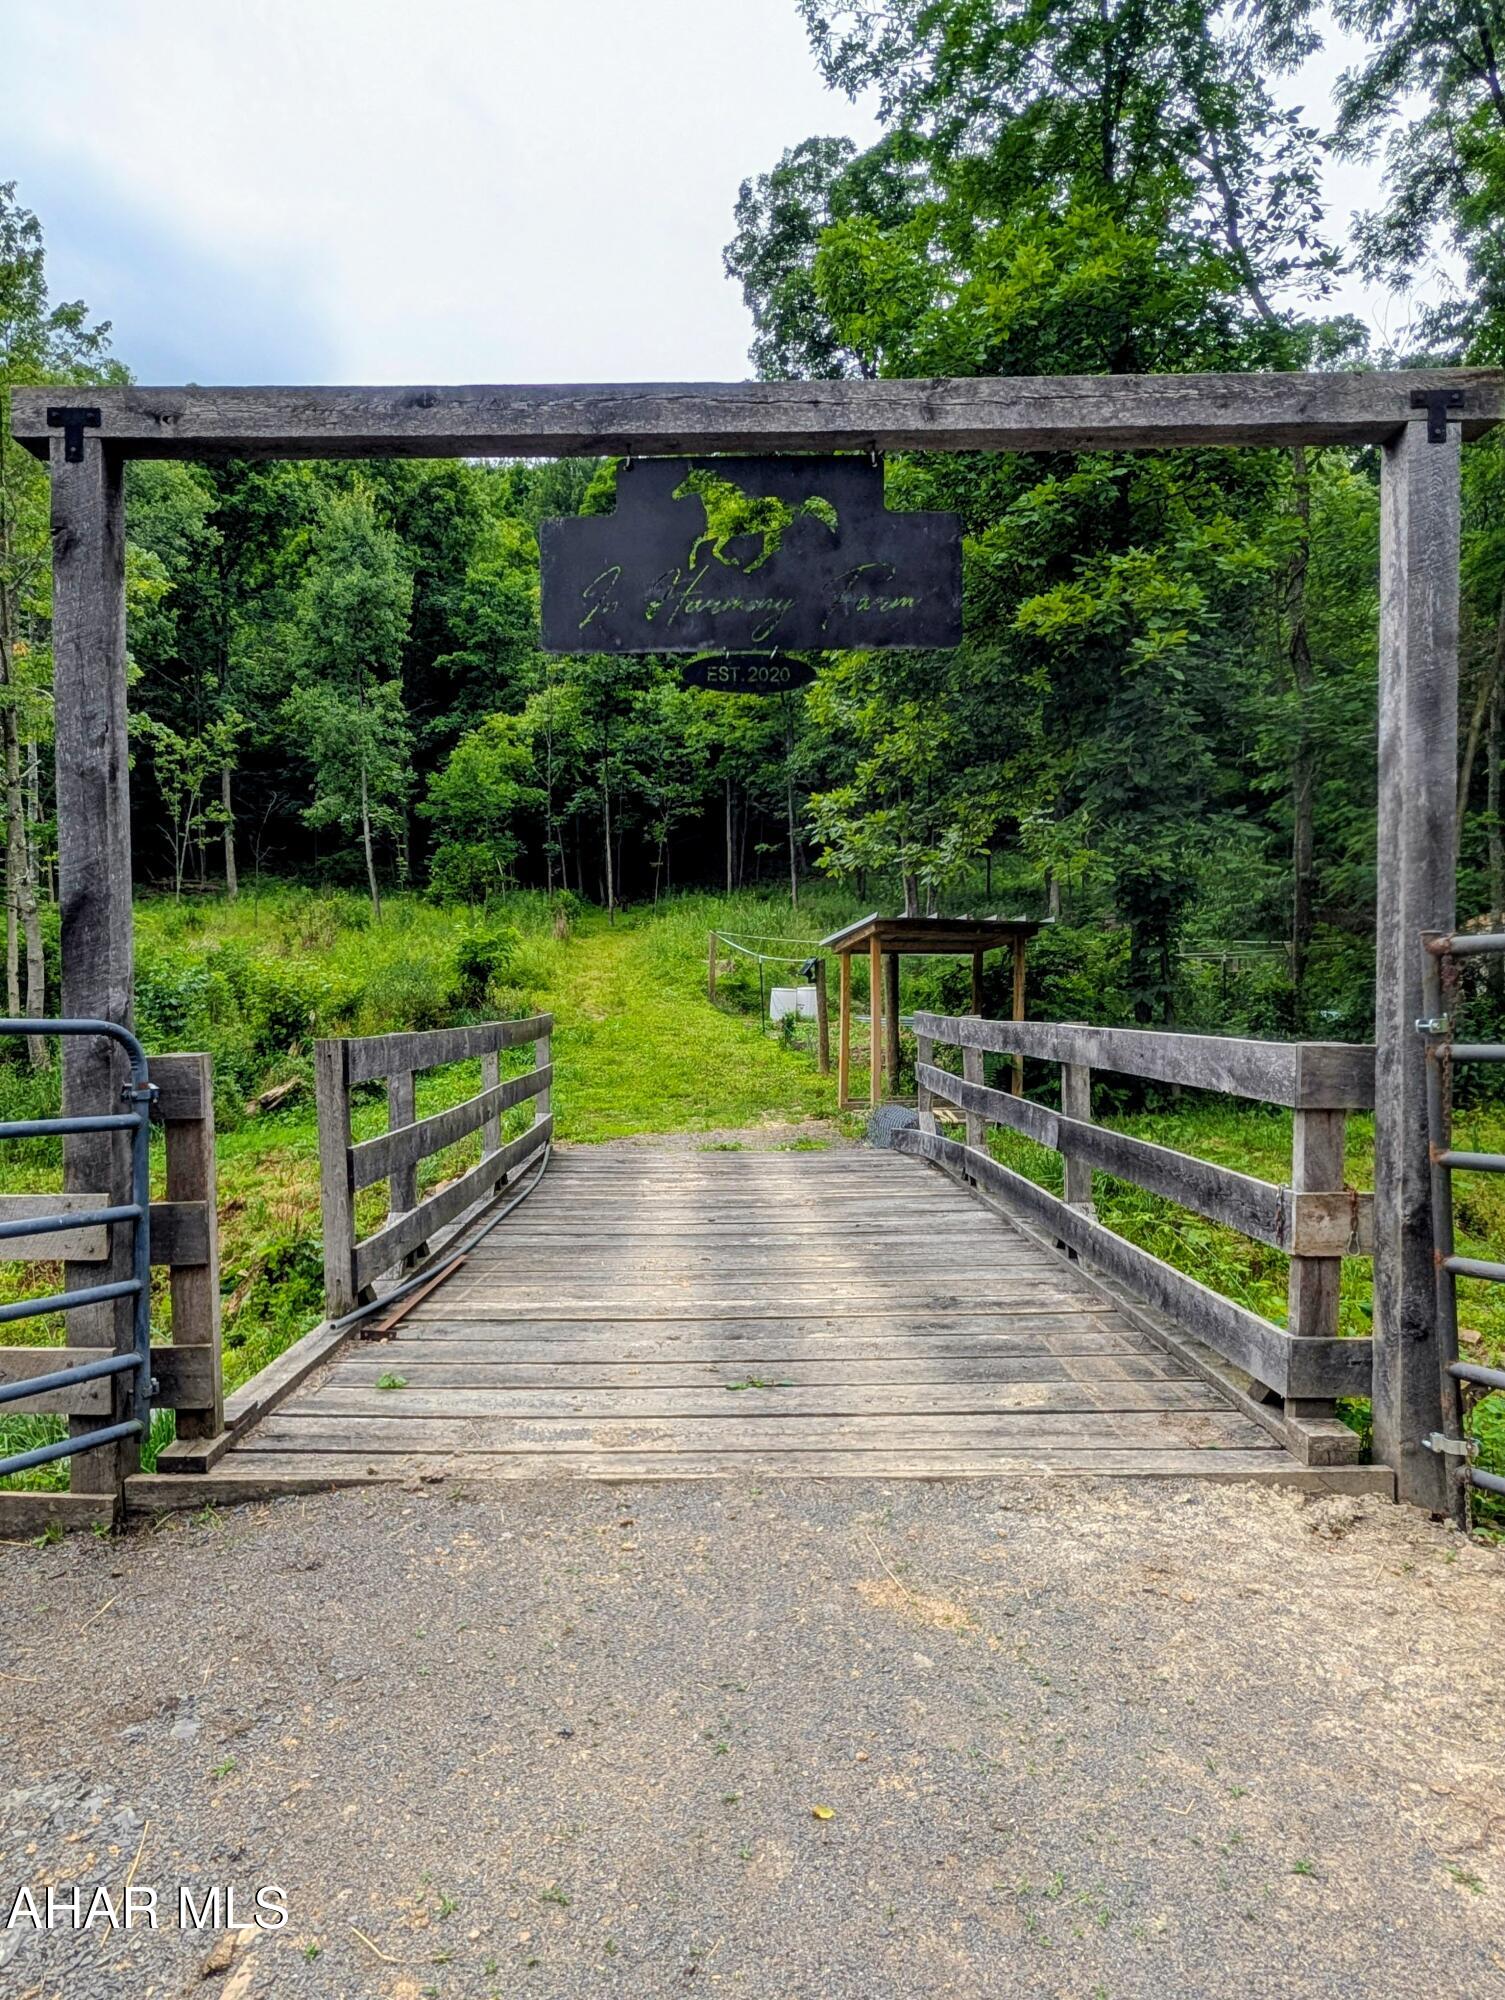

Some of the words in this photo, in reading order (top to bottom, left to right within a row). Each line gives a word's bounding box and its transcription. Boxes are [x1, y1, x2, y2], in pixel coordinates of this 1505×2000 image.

[579, 566, 622, 629] In
[645, 565, 795, 642] Harmony
[822, 562, 922, 630] Farm
